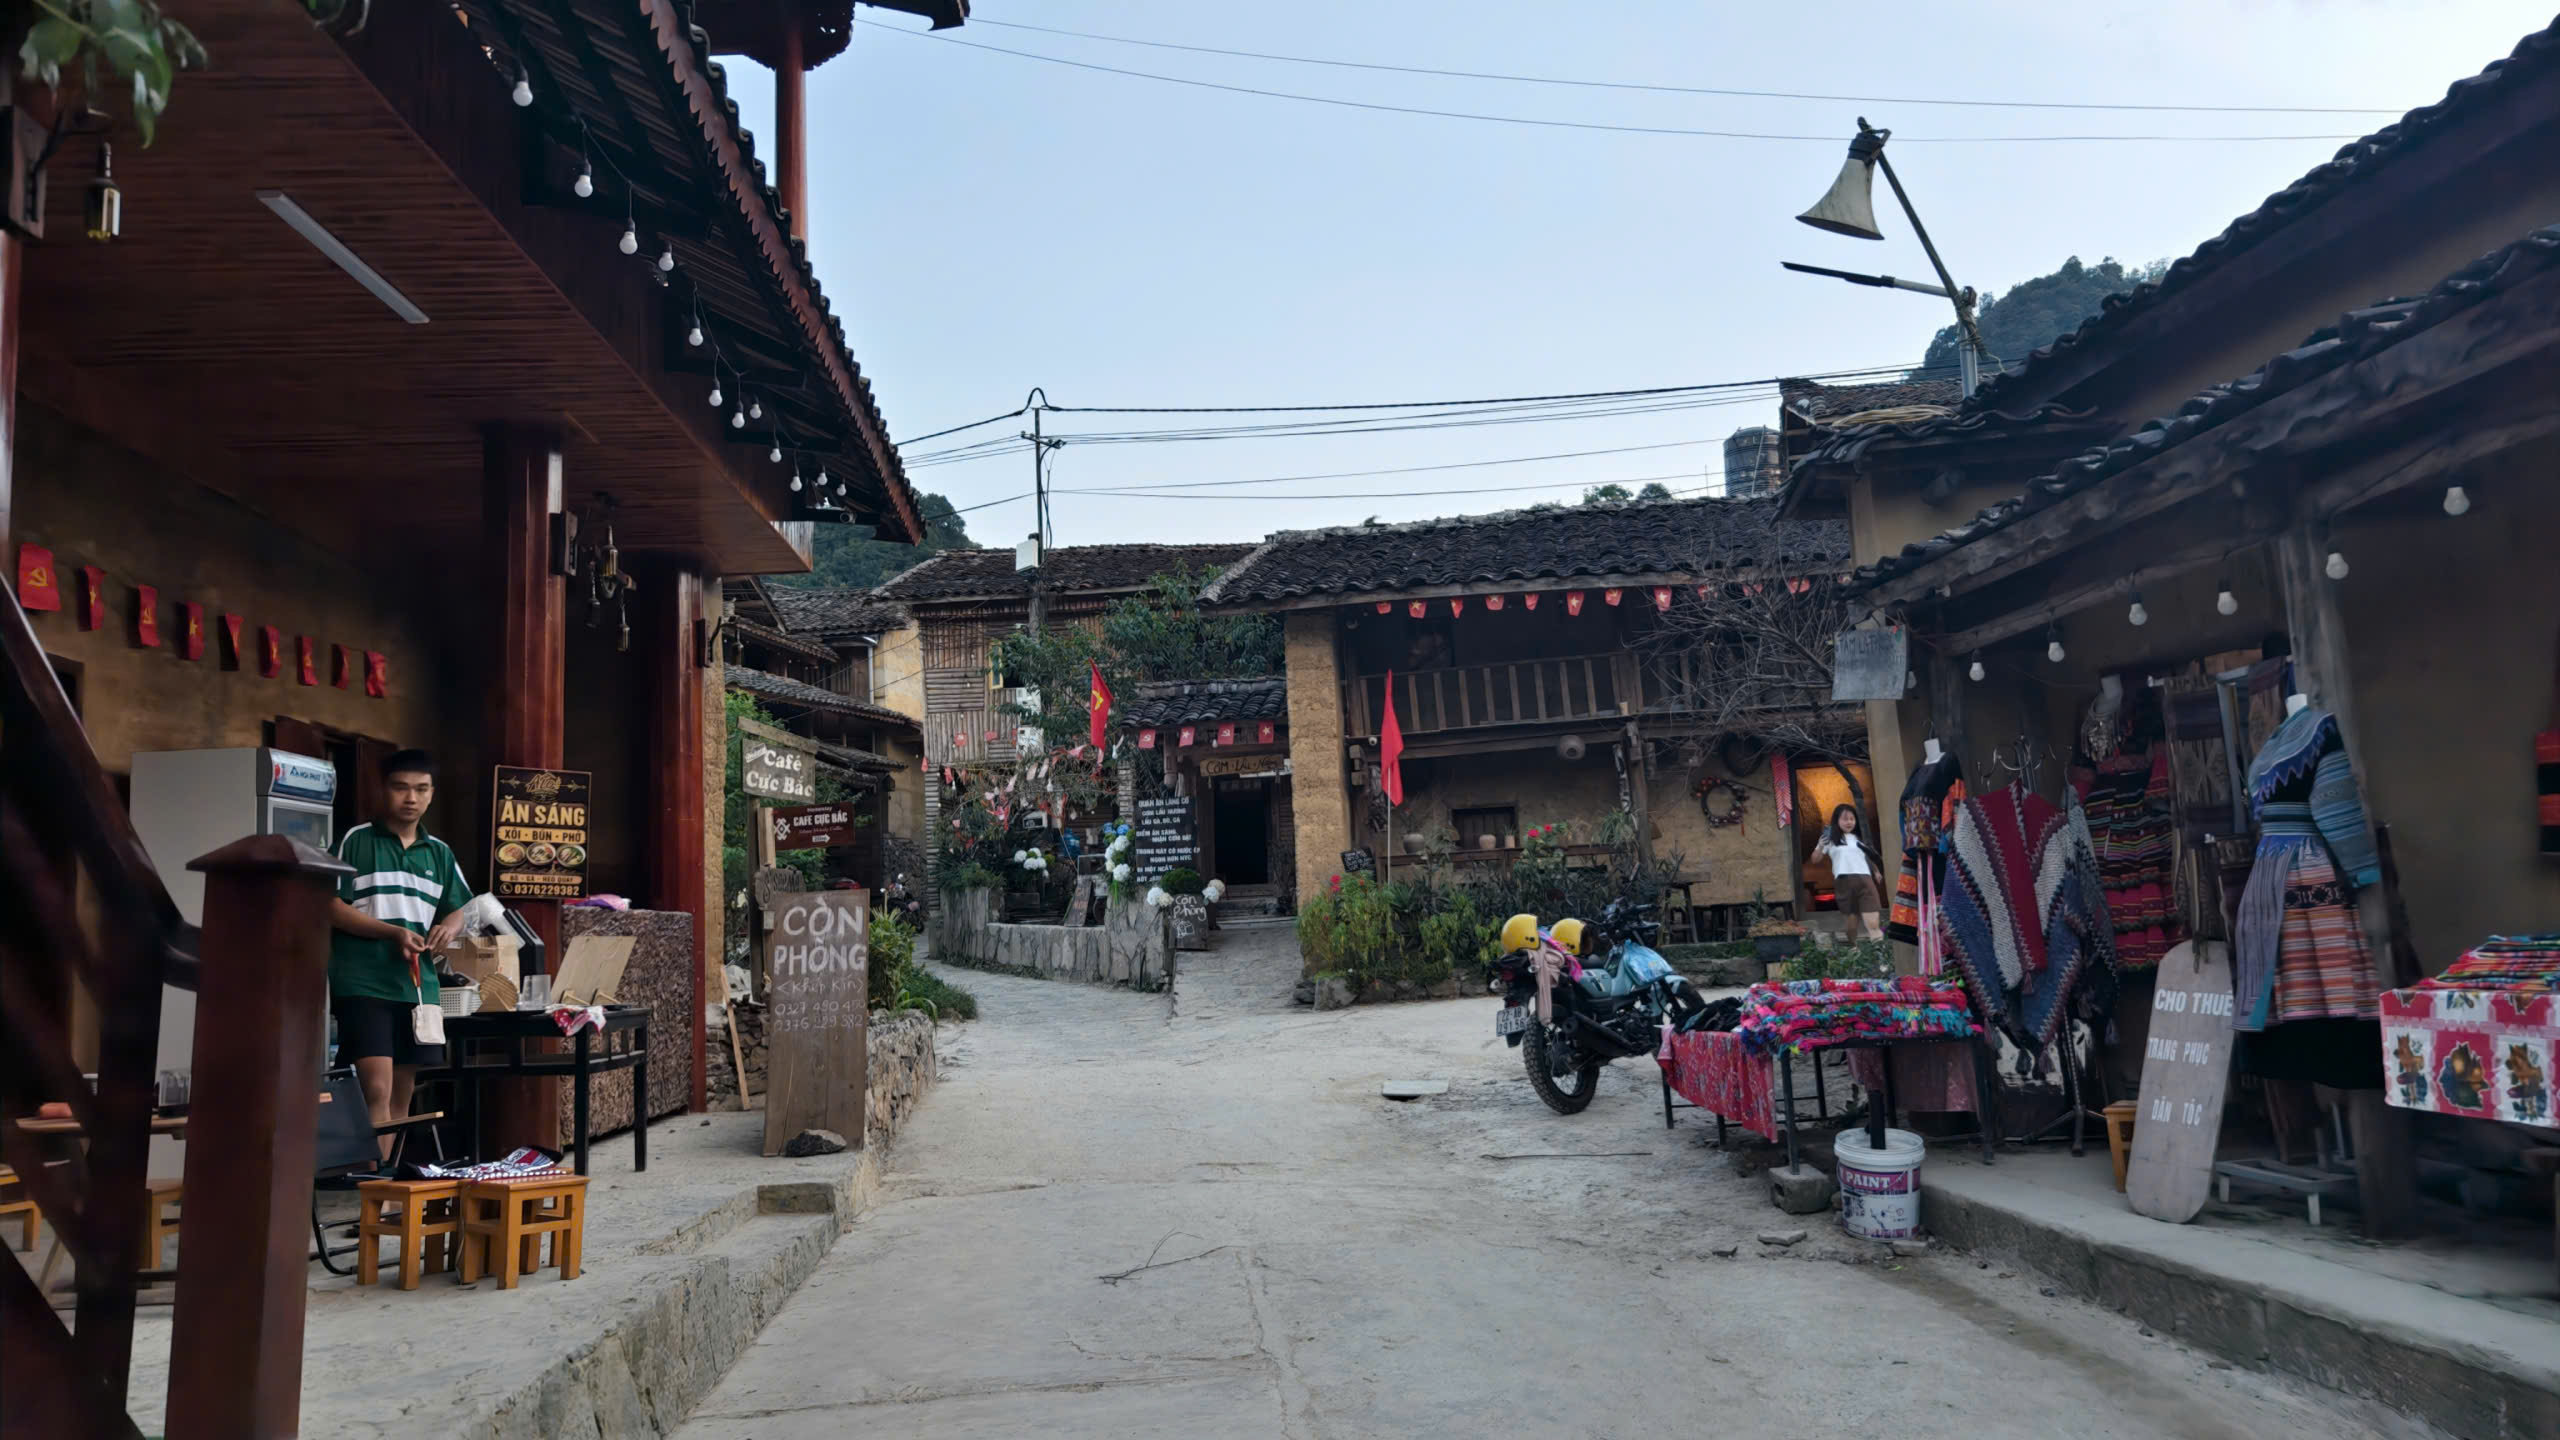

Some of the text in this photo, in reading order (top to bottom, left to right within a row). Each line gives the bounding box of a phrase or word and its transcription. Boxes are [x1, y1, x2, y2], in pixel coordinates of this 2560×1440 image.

[764, 749, 802, 772] Café
[745, 770, 814, 797] Cực Bắc
[500, 794, 585, 827] ĂN SÁNG
[793, 815, 813, 827] CAFE
[504, 827, 582, 842] XÔI BÚN PHỞ
[514, 883, 580, 896] 0376229382
[783, 897, 863, 936] CÒN
[773, 938, 867, 976] PHÒNG
[2154, 988, 2234, 1017] CHO THUÊ
[2147, 1036, 2211, 1066] TRANG PHỤC
[2151, 1095, 2203, 1128] DÂN TỘC
[1846, 1171, 1891, 1189] PAINT
